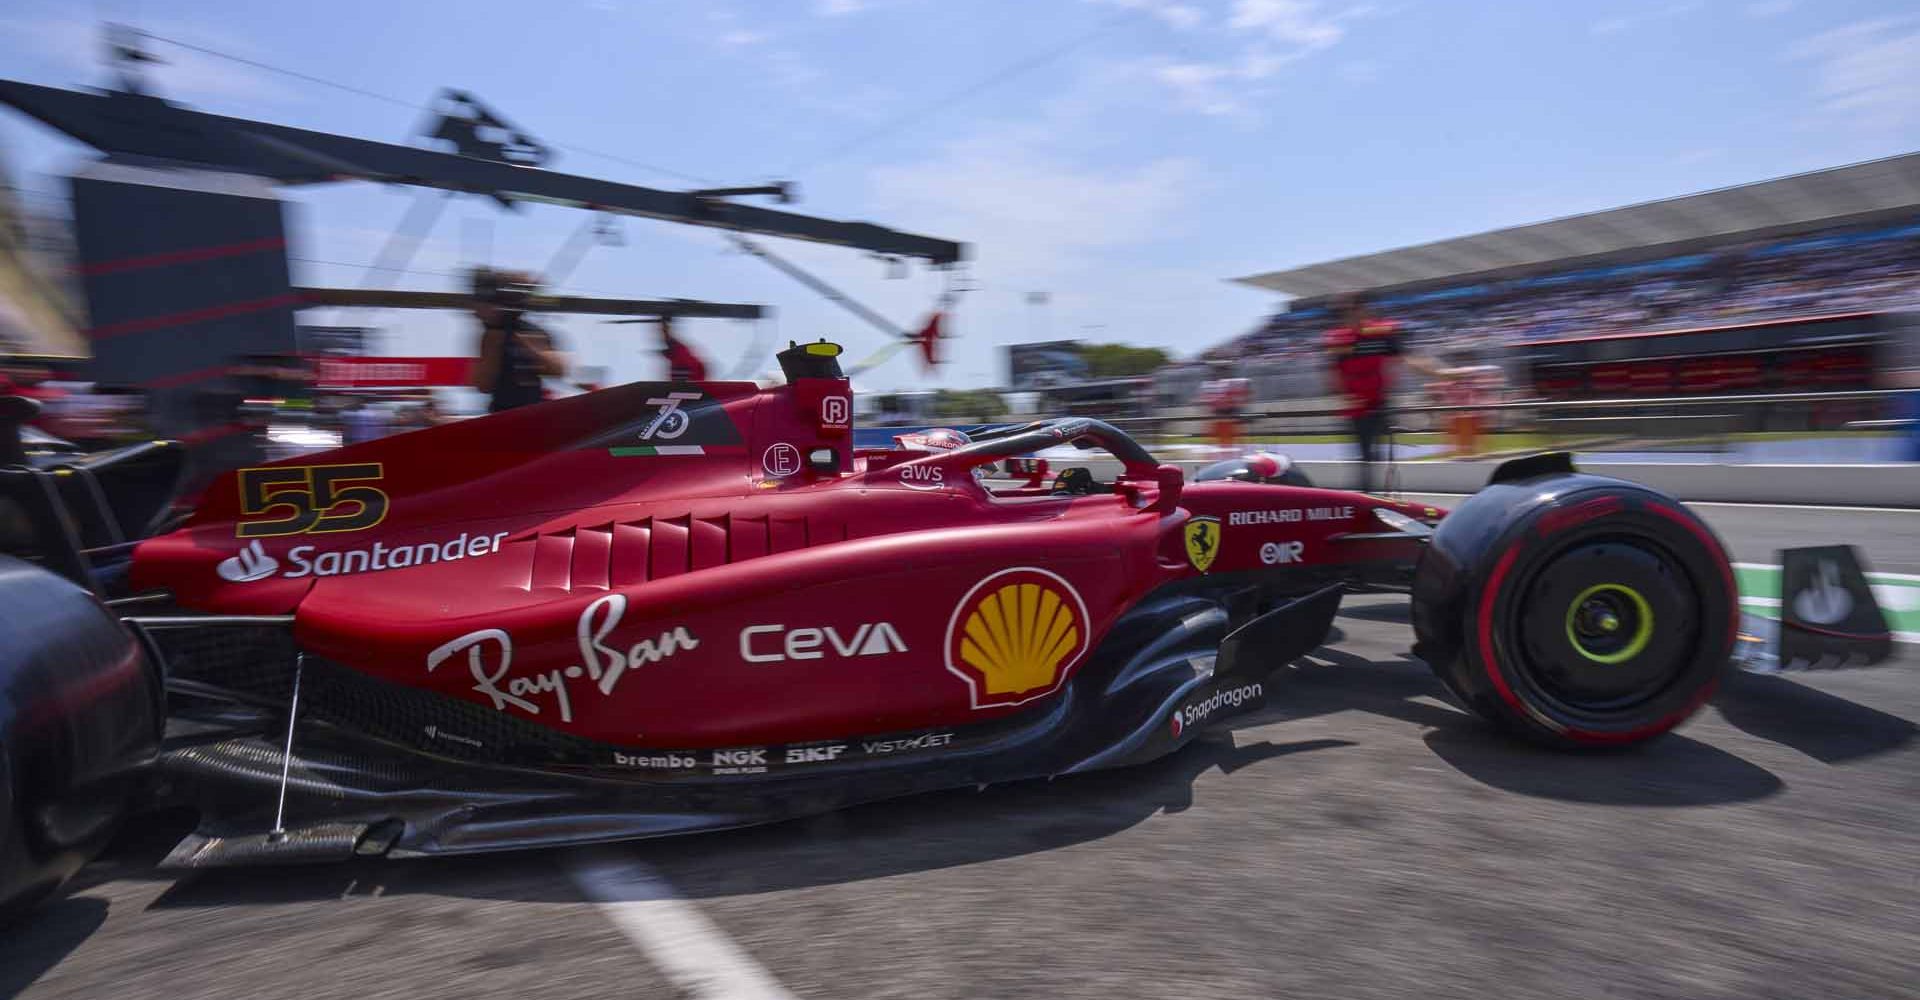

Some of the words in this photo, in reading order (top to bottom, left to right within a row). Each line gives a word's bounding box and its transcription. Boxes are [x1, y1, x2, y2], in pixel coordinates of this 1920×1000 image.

[901, 464, 944, 482] aws
[235, 462, 390, 538] 55
[1228, 508, 1302, 526] RICHARD
[1306, 506, 1355, 521] MILLE
[283, 531, 509, 578] Santander
[427, 594, 699, 722] Ray-Ban
[1185, 683, 1262, 726] Snapdragon
[614, 752, 697, 769] brembo
[711, 750, 769, 766] NGK
[784, 744, 849, 764] SKF
